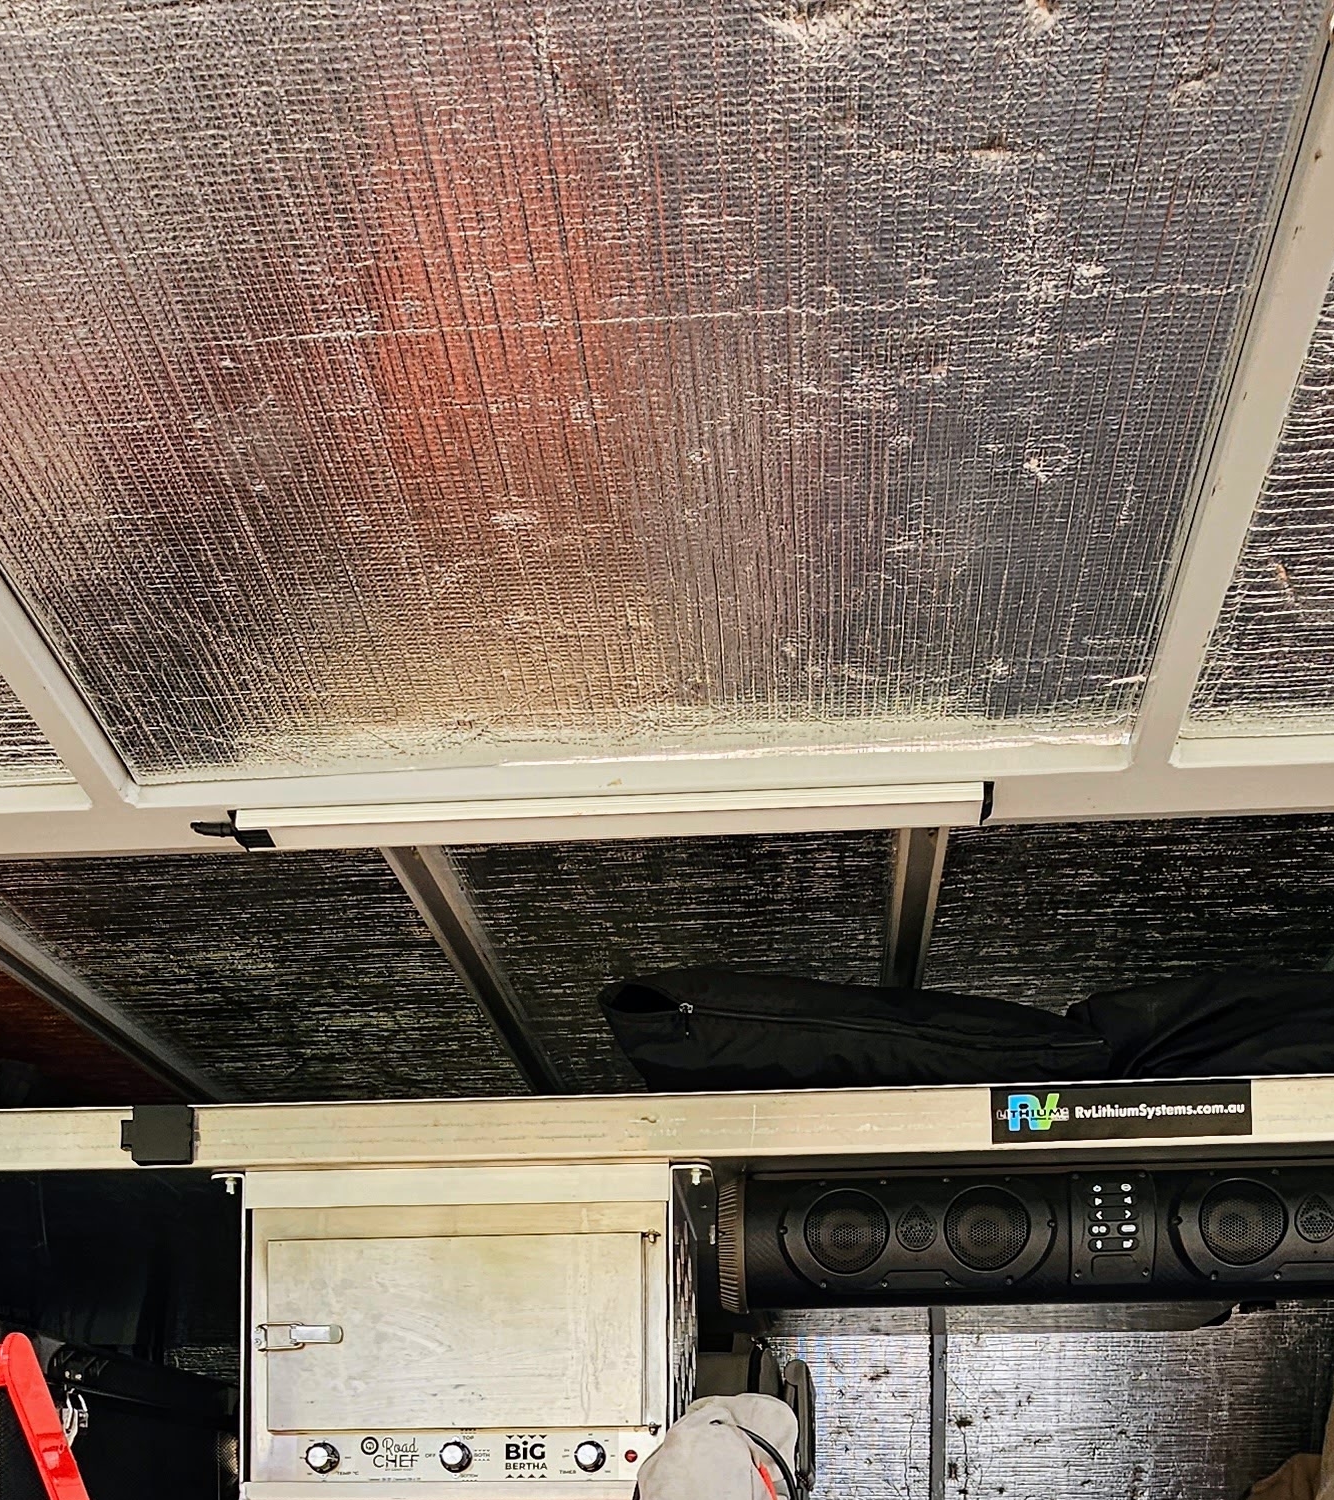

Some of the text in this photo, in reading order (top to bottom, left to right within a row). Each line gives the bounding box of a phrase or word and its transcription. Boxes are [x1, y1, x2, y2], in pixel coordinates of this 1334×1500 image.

[1075, 1103, 1245, 1120] RvLithiumSystems.com.au
[382, 1437, 419, 1454] Road
[373, 1454, 420, 1468] CHEF
[505, 1462, 548, 1471] BERTHA
